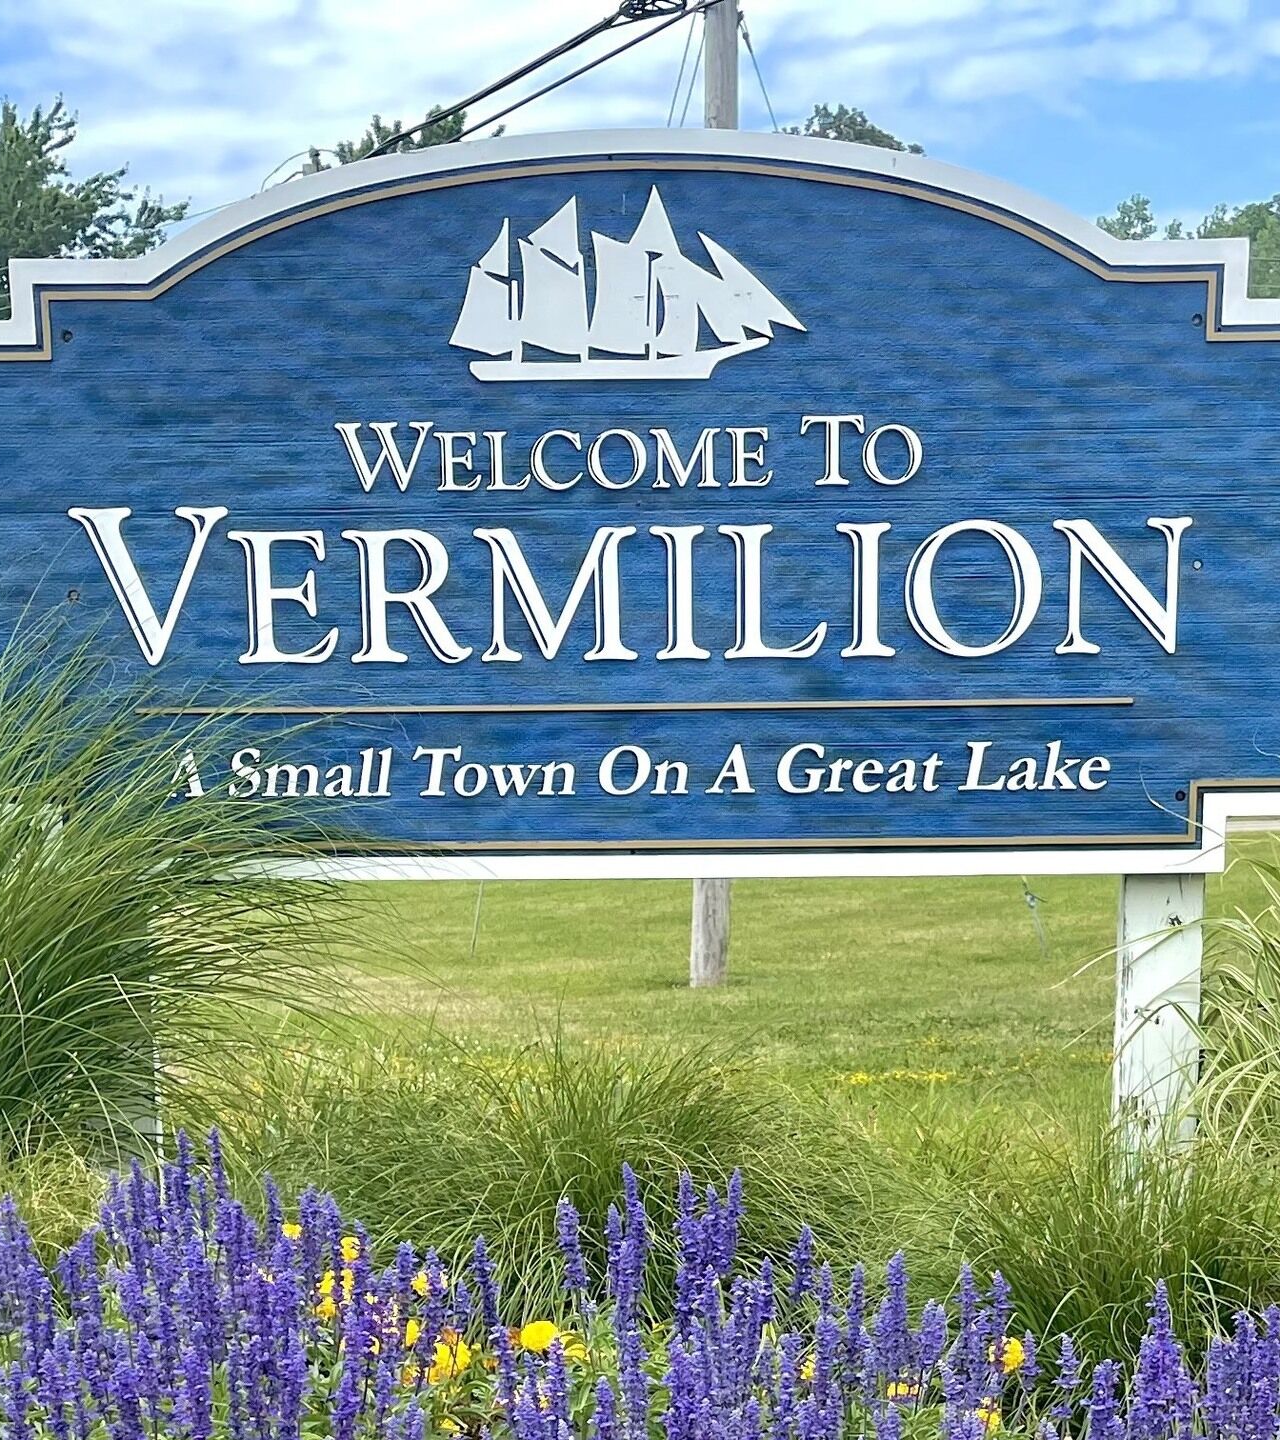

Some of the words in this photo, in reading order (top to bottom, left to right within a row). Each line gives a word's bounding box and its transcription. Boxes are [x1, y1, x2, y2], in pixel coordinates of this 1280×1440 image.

[66, 505, 1194, 668] VERMILION
[228, 746, 394, 799] Small
[411, 743, 577, 798] Town
[597, 744, 690, 796] On
[703, 742, 757, 795] A
[775, 742, 945, 795] Great
[956, 739, 1112, 793] Lake
